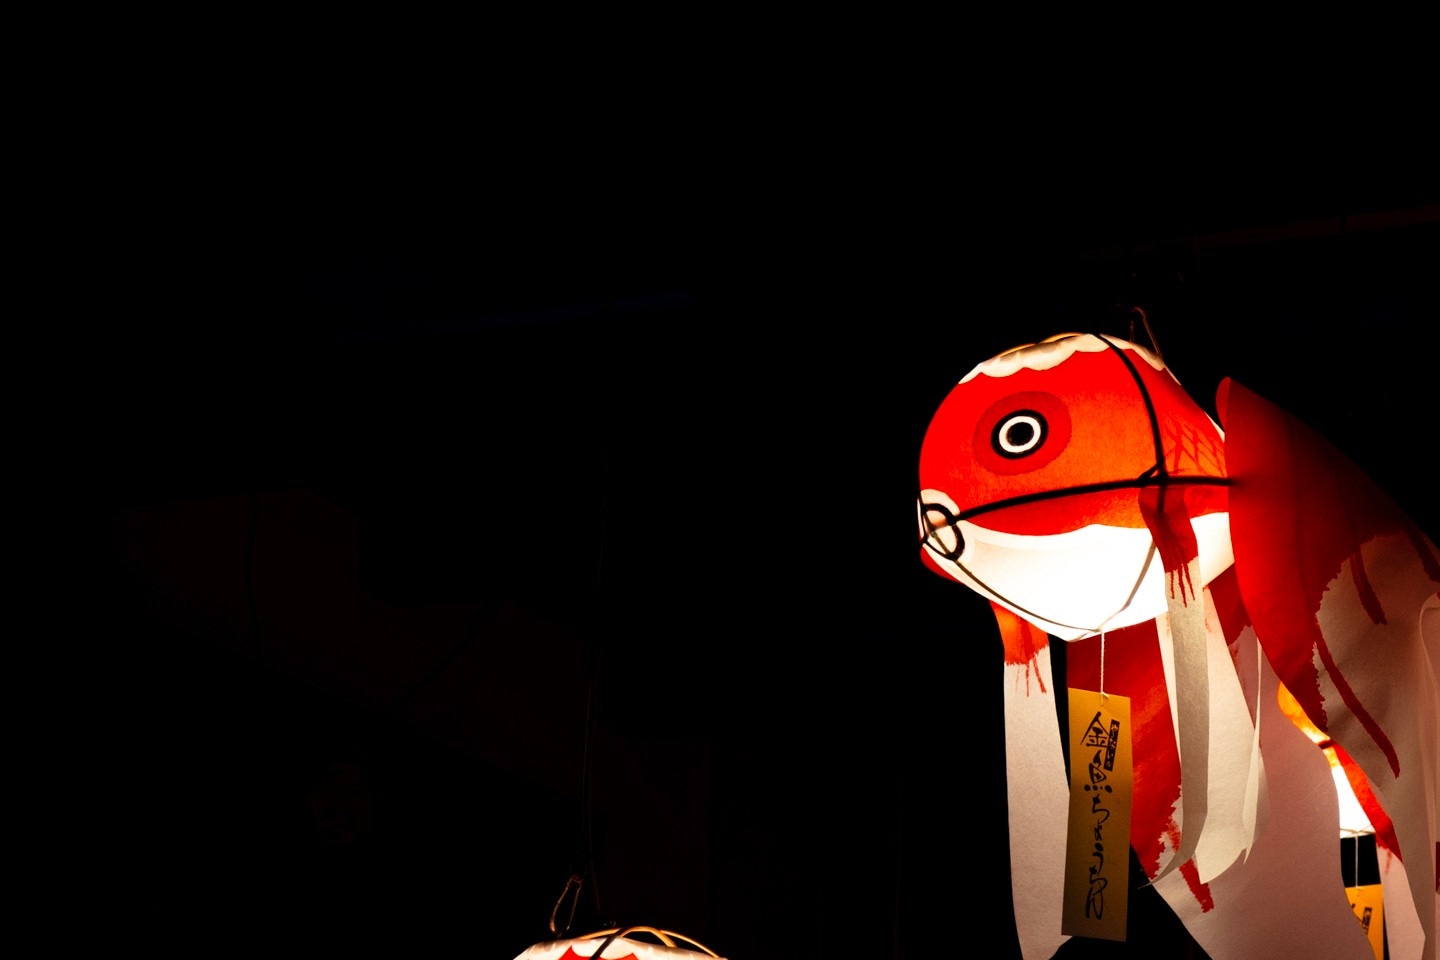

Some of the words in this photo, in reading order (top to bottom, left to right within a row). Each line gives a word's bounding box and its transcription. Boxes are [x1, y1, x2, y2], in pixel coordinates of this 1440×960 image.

[1080, 711, 1113, 920] 金魚ちょうちん
